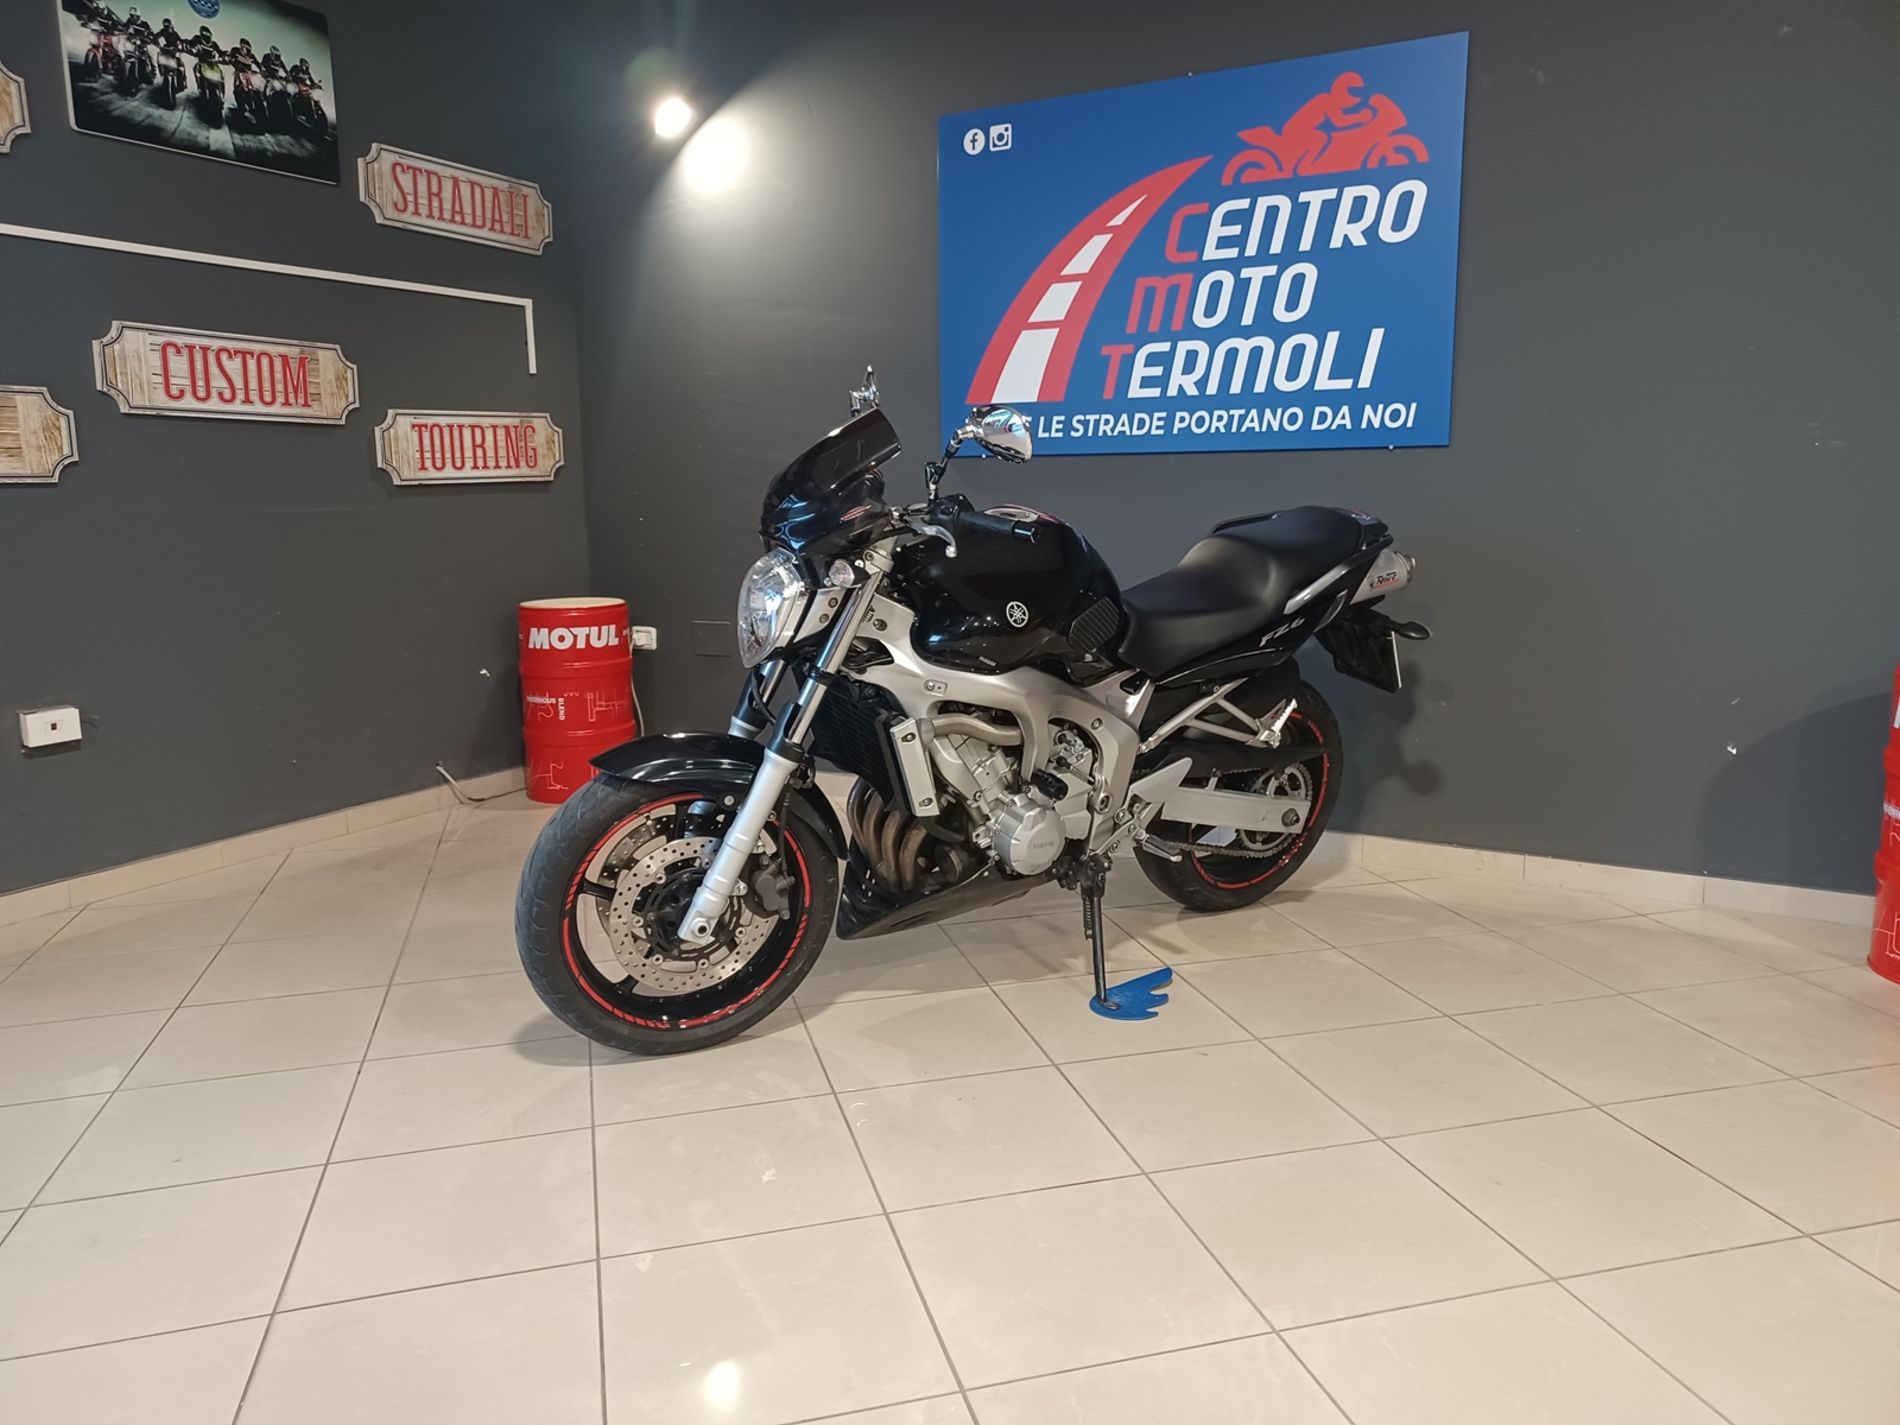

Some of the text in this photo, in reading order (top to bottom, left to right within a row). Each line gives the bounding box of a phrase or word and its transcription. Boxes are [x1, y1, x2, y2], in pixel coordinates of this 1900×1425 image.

[391, 161, 531, 240] STRADALI
[1165, 179, 1428, 264] CENTRO
[1126, 262, 1318, 335] MOTO
[160, 341, 312, 408] CUSTOM
[1101, 328, 1385, 400] TERMOLI
[412, 424, 537, 472] TOURING
[1037, 415, 1065, 438] LE
[1070, 411, 1166, 438] STRADE
[1172, 408, 1303, 434] PORTANO
[1310, 405, 1352, 432] DA
[1360, 402, 1417, 429] NOI
[528, 624, 619, 650] MOTUL
